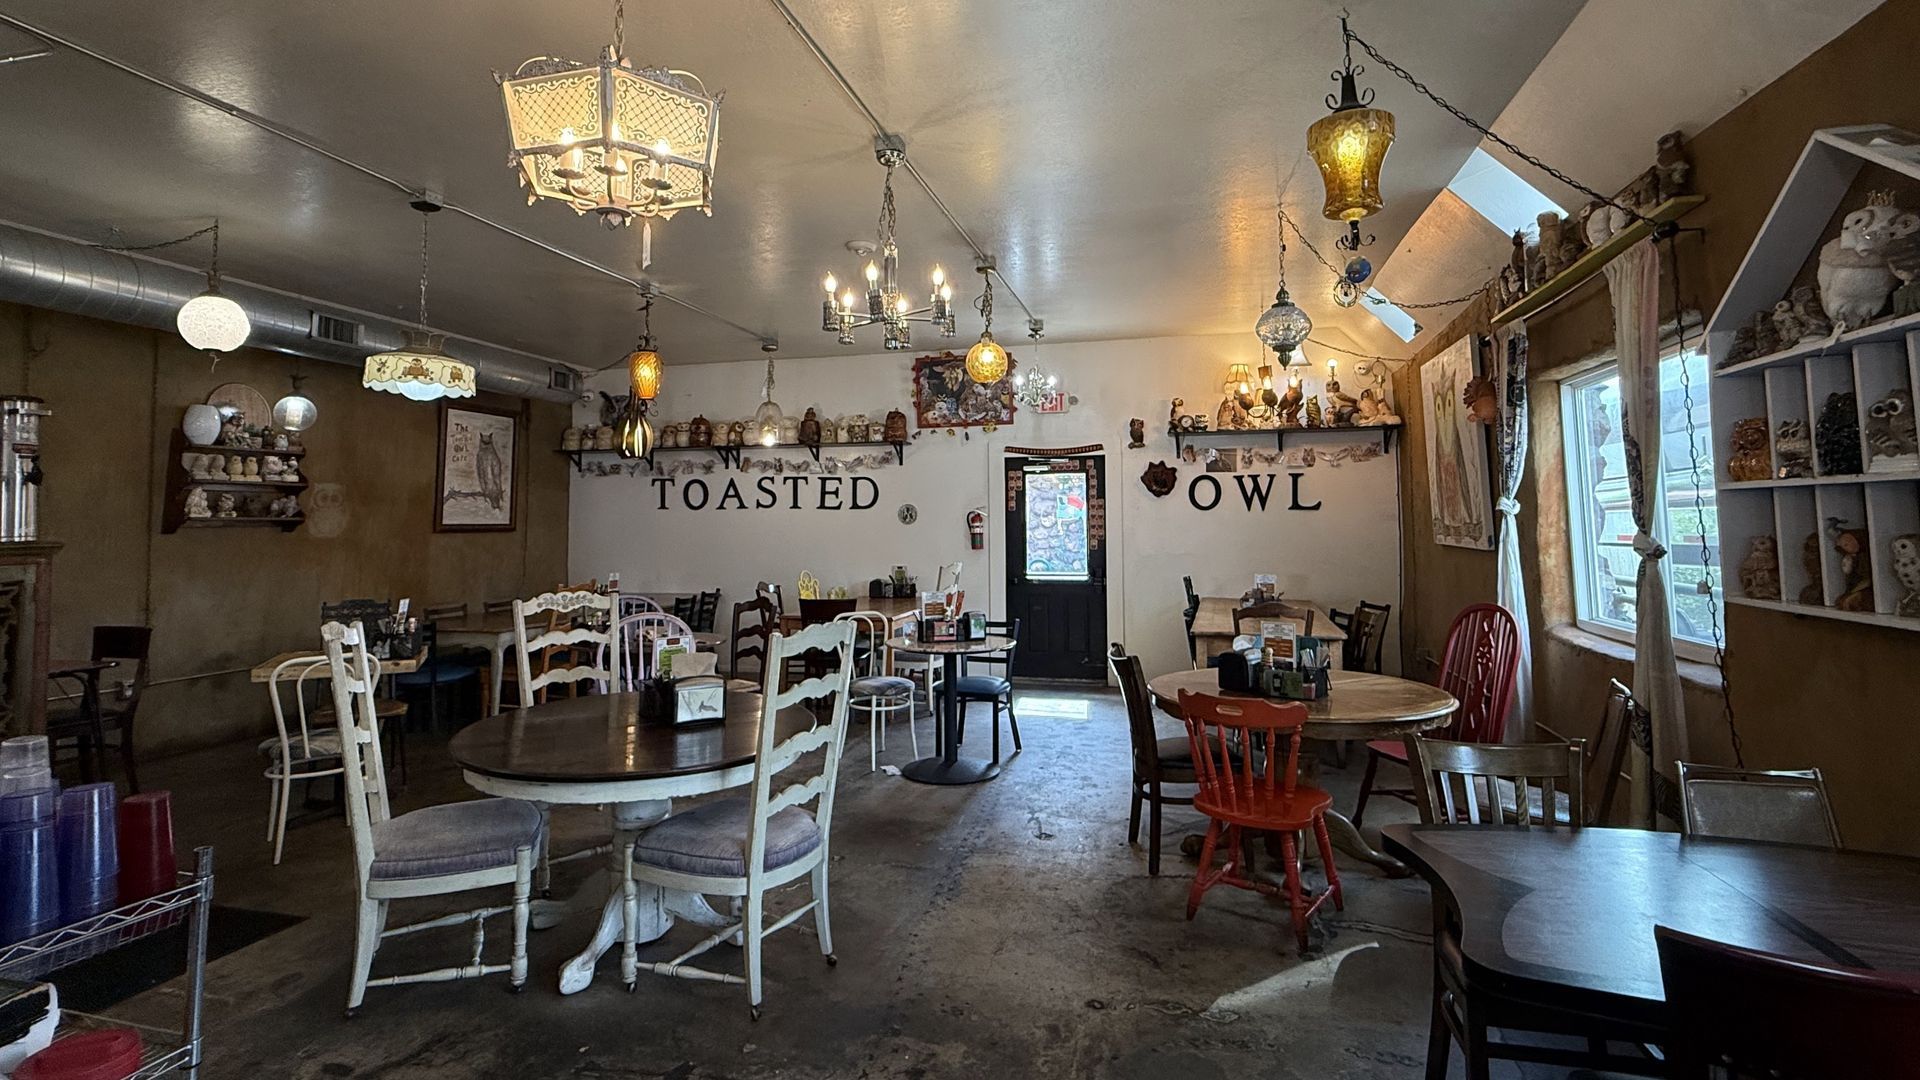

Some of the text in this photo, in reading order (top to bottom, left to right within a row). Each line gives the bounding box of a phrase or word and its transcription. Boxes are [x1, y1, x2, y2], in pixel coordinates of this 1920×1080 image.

[454, 423, 469, 432] The
[651, 473, 1322, 512] TOASTED OWL
